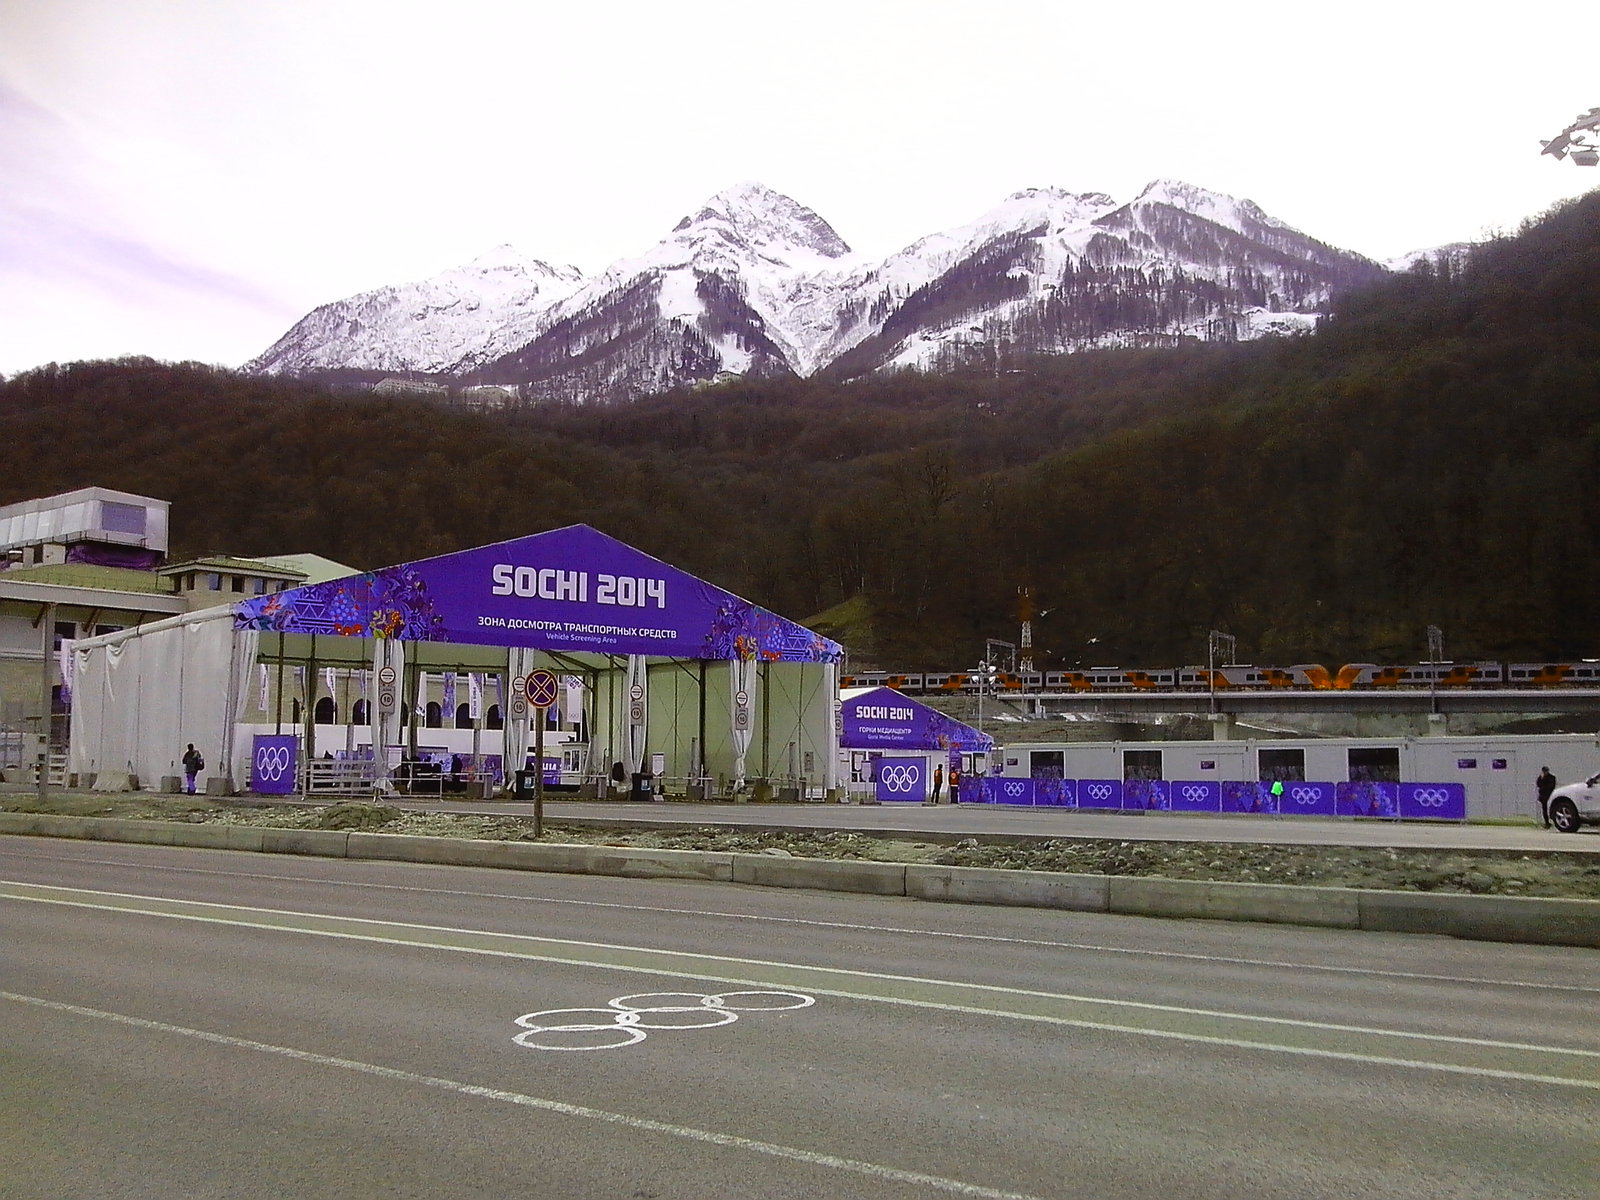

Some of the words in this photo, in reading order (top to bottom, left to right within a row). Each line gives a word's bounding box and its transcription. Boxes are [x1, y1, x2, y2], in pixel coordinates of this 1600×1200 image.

[492, 563, 588, 602] SOCHI
[597, 573, 666, 609] 2014
[477, 616, 506, 628] ЗОНА
[507, 618, 563, 632] ДОСМОТРА
[564, 623, 638, 637] ТРАНСПОРТНЫХ
[639, 629, 678, 639] СРЕДСТВ
[546, 632, 570, 641] Vehicle
[570, 634, 602, 645] Screening
[602, 637, 618, 645] Area
[856, 705, 888, 719] SOCHI
[889, 707, 914, 721] 2014
